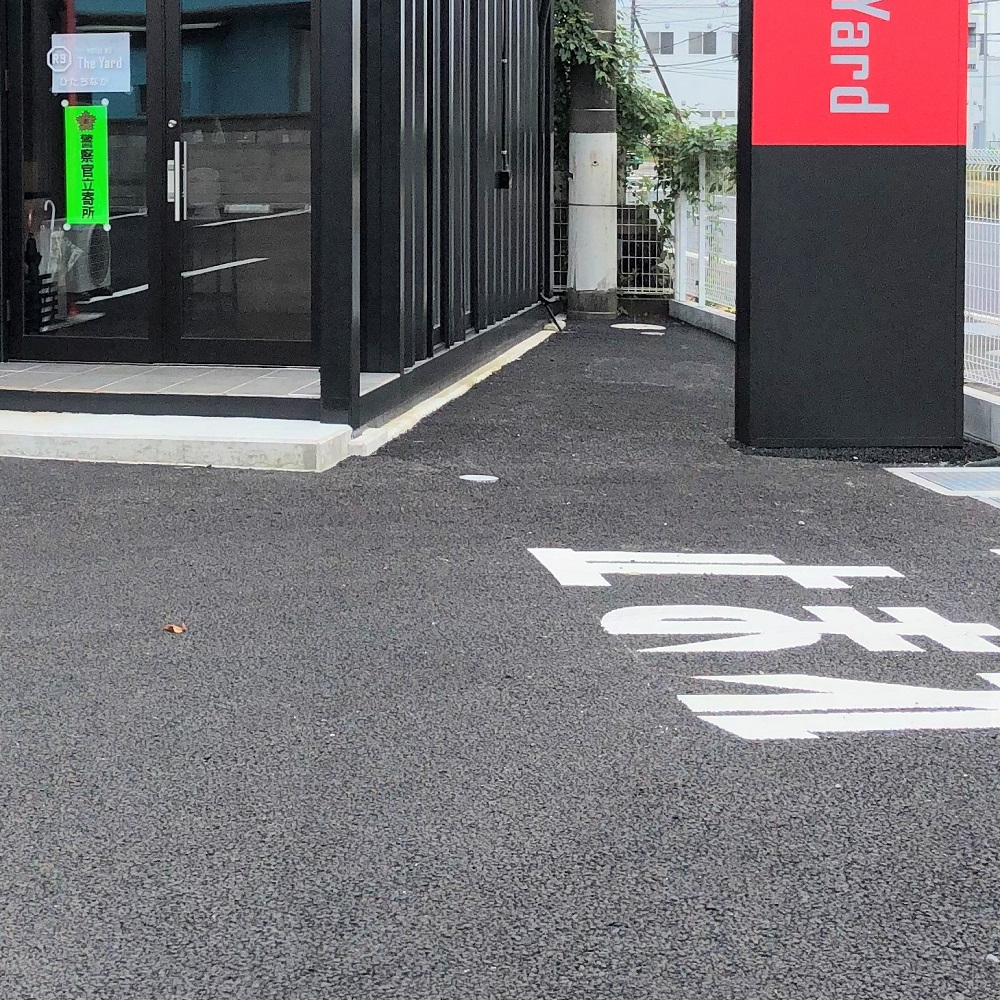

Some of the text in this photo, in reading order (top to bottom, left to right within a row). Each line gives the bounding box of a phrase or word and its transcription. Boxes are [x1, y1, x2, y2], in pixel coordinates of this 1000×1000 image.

[52, 53, 67, 64] R9
[78, 56, 123, 69] The Yard
[80, 134, 95, 219] 警察官立寄所
